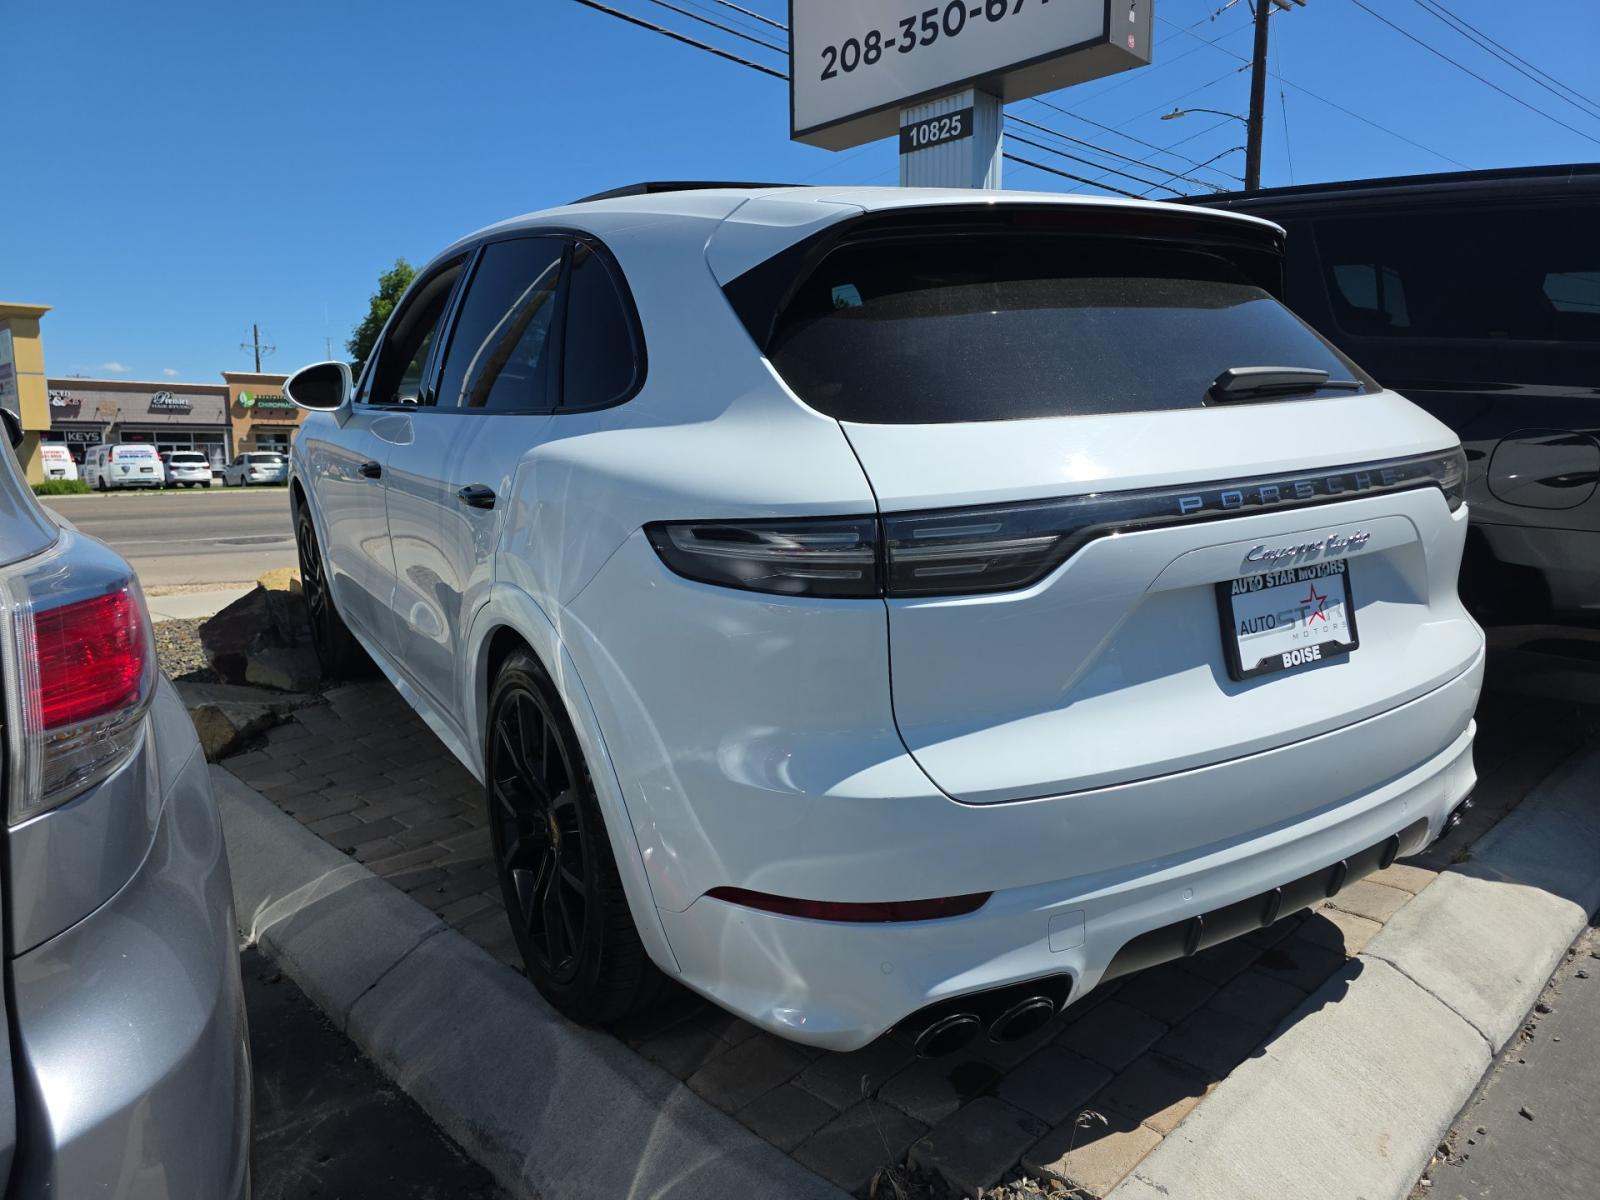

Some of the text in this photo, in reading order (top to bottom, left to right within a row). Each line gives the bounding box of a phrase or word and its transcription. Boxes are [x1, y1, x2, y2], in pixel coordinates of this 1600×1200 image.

[909, 115, 962, 147] 10825
[68, 432, 99, 441] KEYS
[1177, 468, 1398, 515] PORSCHE
[1246, 542, 1324, 564] Cayenne
[1231, 560, 1346, 595] AUTO STAR MOTORS
[1282, 645, 1322, 668] BOISE
